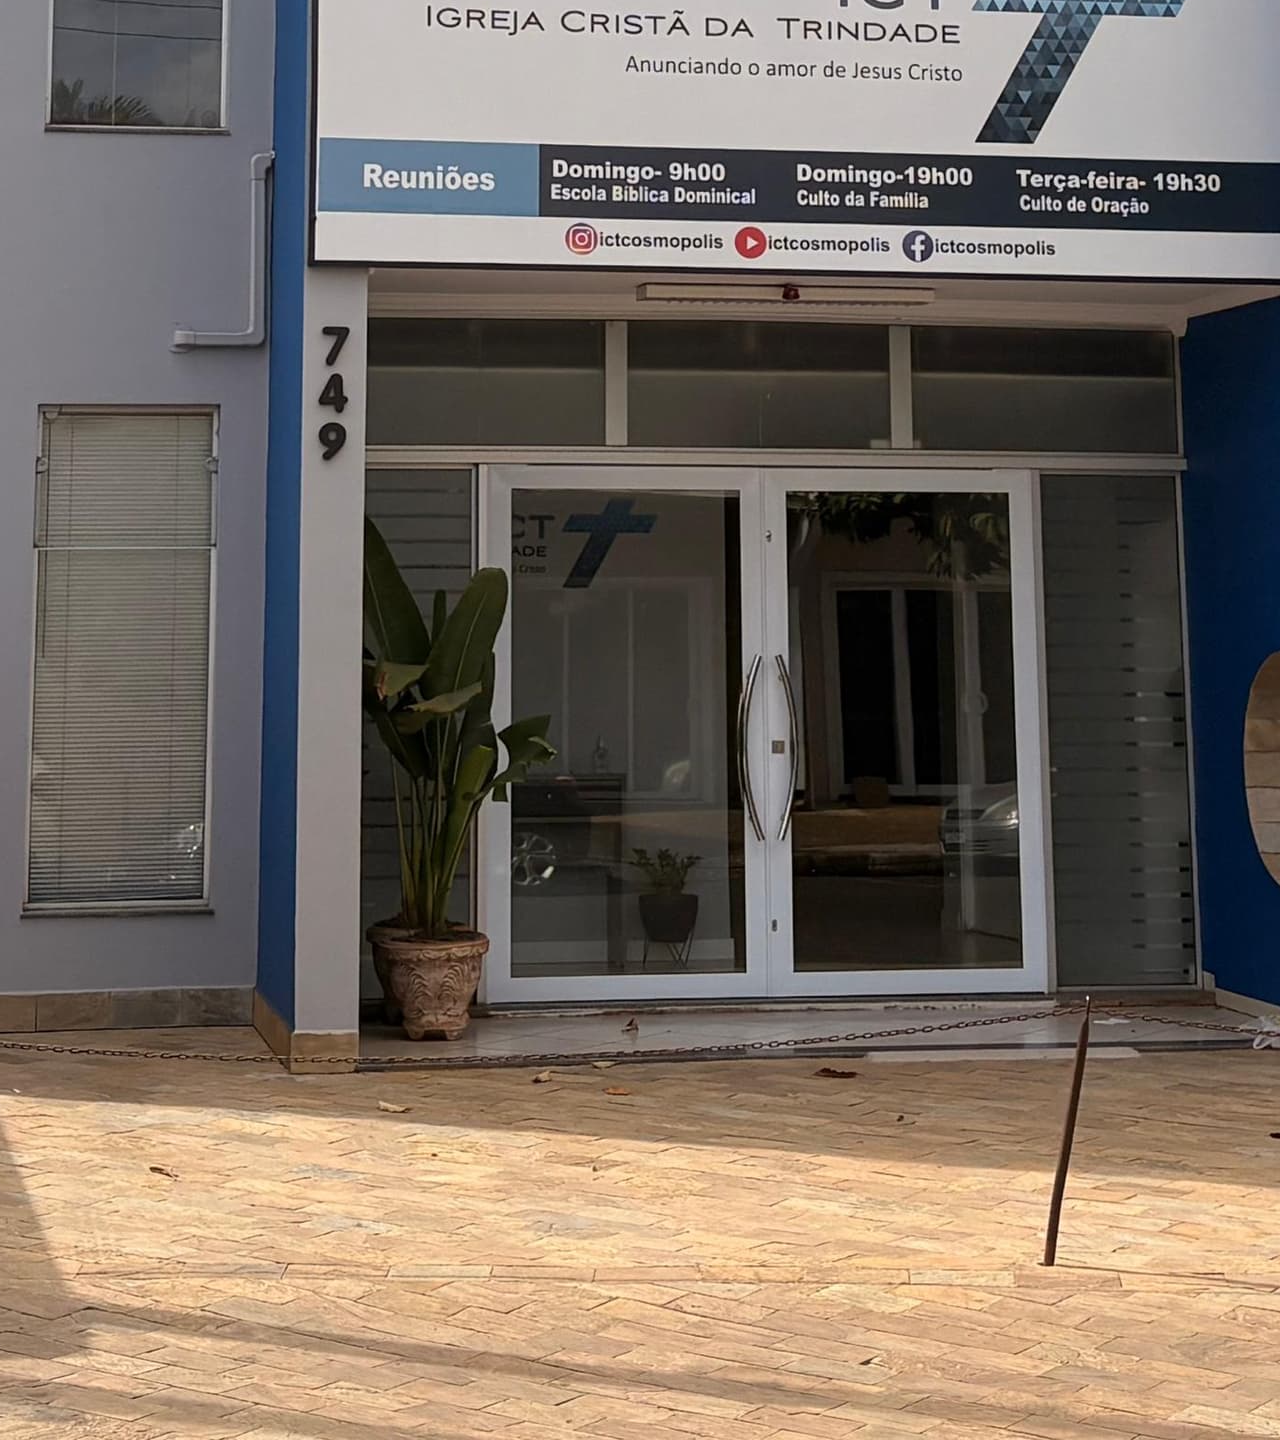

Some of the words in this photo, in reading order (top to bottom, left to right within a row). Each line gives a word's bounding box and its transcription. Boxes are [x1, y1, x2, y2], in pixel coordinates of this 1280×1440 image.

[426, 5, 545, 36] IGREJA
[560, 9, 691, 36] CRISTÃ
[704, 17, 754, 38] DA
[776, 17, 961, 44] TRINDADE
[625, 55, 742, 76] Anunciando
[748, 63, 760, 76] o
[766, 62, 817, 78] amor
[823, 60, 847, 78] de
[852, 62, 902, 80] Jesus
[908, 63, 963, 82] Cristo
[363, 163, 496, 191] Reuniões
[552, 159, 661, 184] Domingo-
[669, 162, 726, 182] 9h00
[1016, 169, 1146, 192] Terça-feira-
[1152, 173, 1221, 193] 19h30
[551, 184, 607, 202] Escola
[612, 185, 669, 204] Bíblica
[674, 187, 756, 206] Dominical
[797, 189, 840, 207] Culto
[844, 190, 865, 207] da
[870, 191, 929, 209] Família
[1019, 194, 1062, 212] Culto
[1066, 196, 1087, 213] de
[1091, 196, 1150, 217] Oração
[599, 231, 724, 252] ictcosmopolis
[767, 234, 890, 255] ictcosmopolis
[934, 238, 1056, 259] ictcosmopolis
[318, 326, 350, 460] 749
